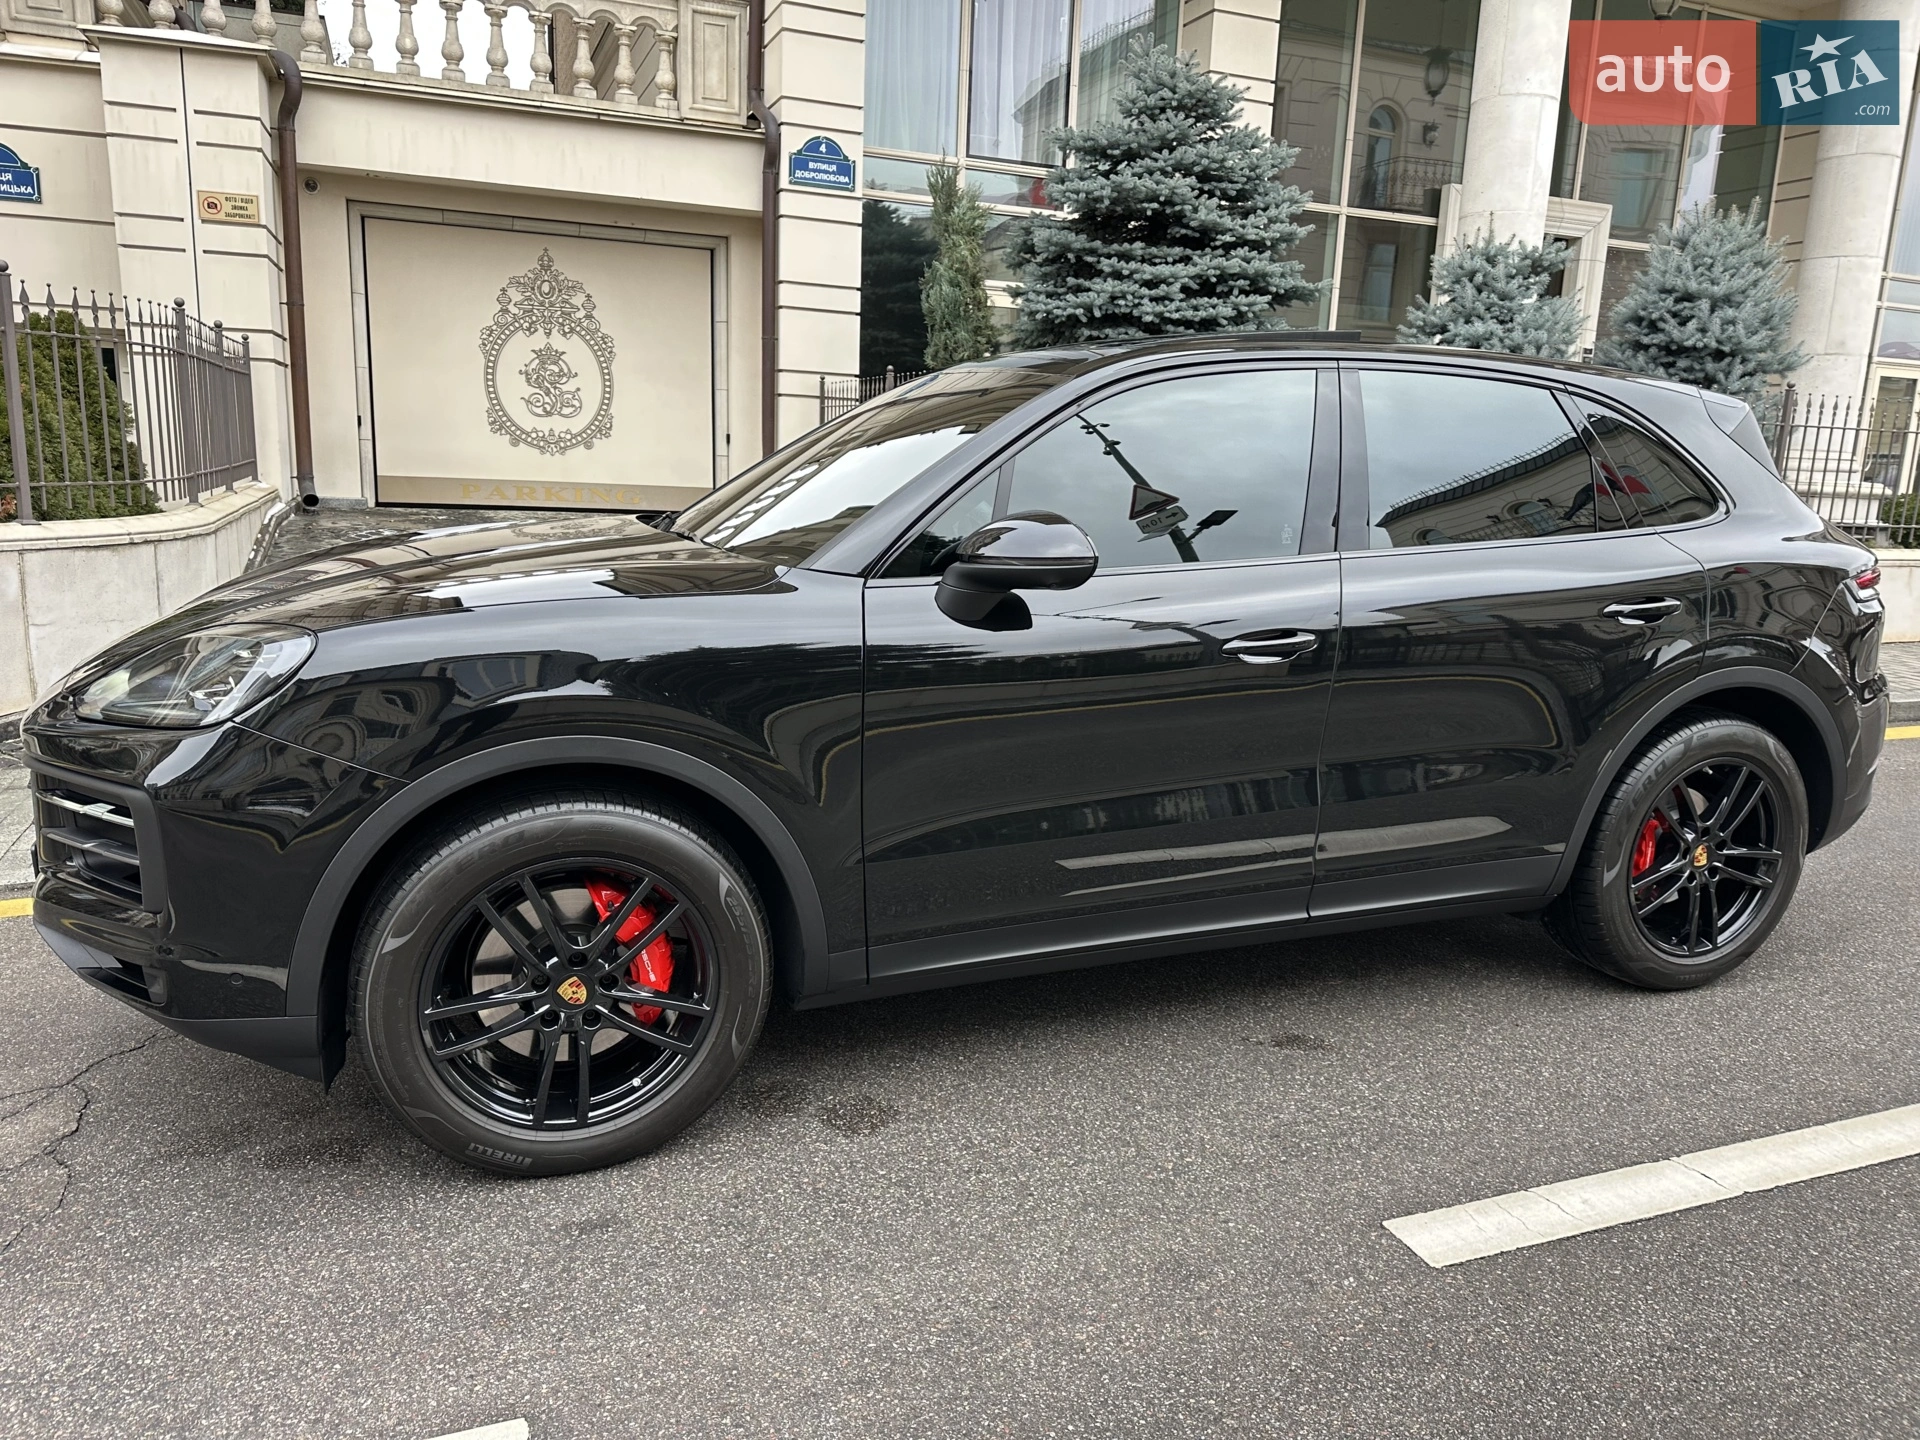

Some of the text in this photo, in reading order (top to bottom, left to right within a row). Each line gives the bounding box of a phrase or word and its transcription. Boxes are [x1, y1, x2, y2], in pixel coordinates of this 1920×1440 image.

[819, 143, 827, 153] 4
[808, 161, 837, 172] ВУЛИЦЯ
[795, 170, 849, 183] ДОБРОЛЮБОВА
[0, 183, 34, 194] ИЦЬКА
[459, 483, 640, 505] PARKING
[465, 1142, 533, 1169] PIRELLI
